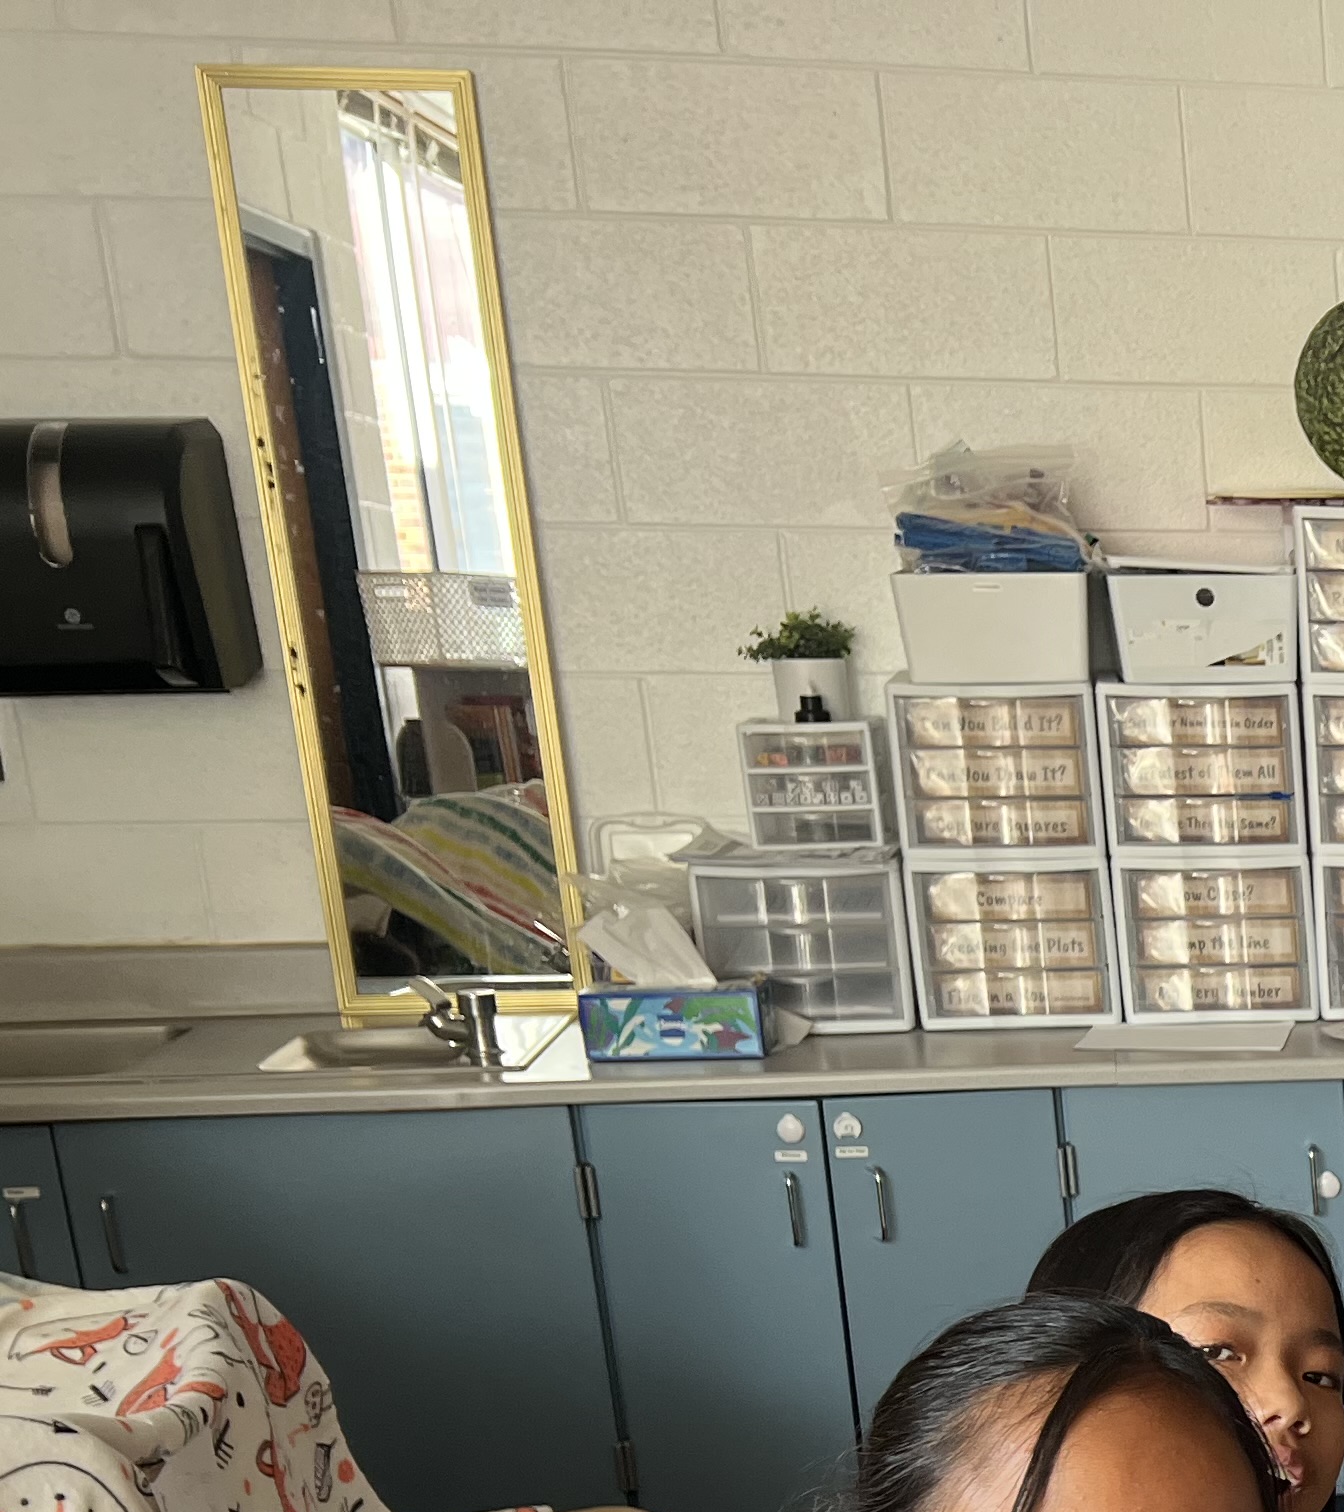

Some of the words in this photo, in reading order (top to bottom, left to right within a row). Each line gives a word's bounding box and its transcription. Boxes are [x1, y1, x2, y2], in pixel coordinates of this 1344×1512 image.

[1038, 715, 1062, 731] It?
[1244, 717, 1273, 728] Order
[1042, 765, 1066, 781] It?
[1258, 766, 1275, 778] All
[1241, 817, 1276, 828] Same?
[1047, 938, 1084, 953] Plots
